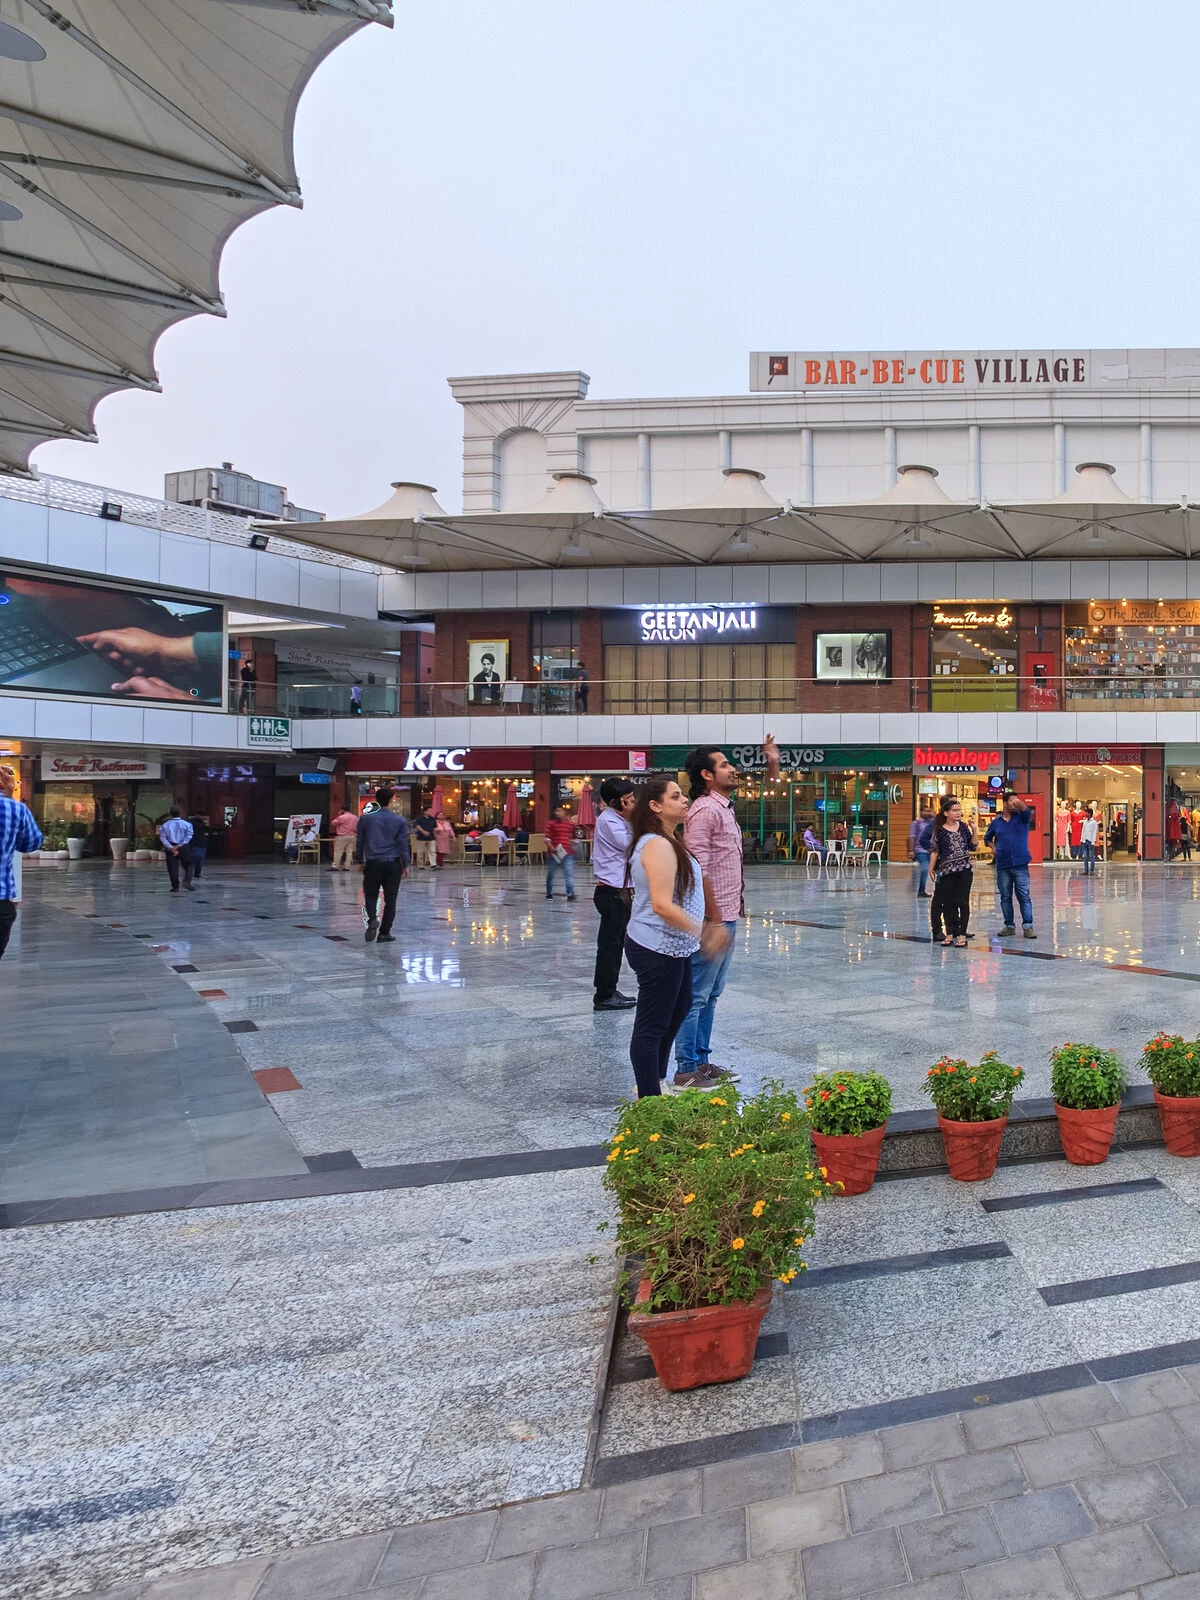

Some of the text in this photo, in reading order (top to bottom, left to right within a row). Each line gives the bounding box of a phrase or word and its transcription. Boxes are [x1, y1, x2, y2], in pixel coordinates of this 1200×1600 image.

[804, 358, 1085, 385] BAR-BE-CUE VILLAGE
[640, 611, 756, 633] GEETANJALI
[1106, 607, 1126, 618] The
[641, 629, 696, 640] SALON
[403, 748, 466, 771] KFC
[732, 745, 825, 767] Chayos
[915, 746, 1001, 771] himalaya
